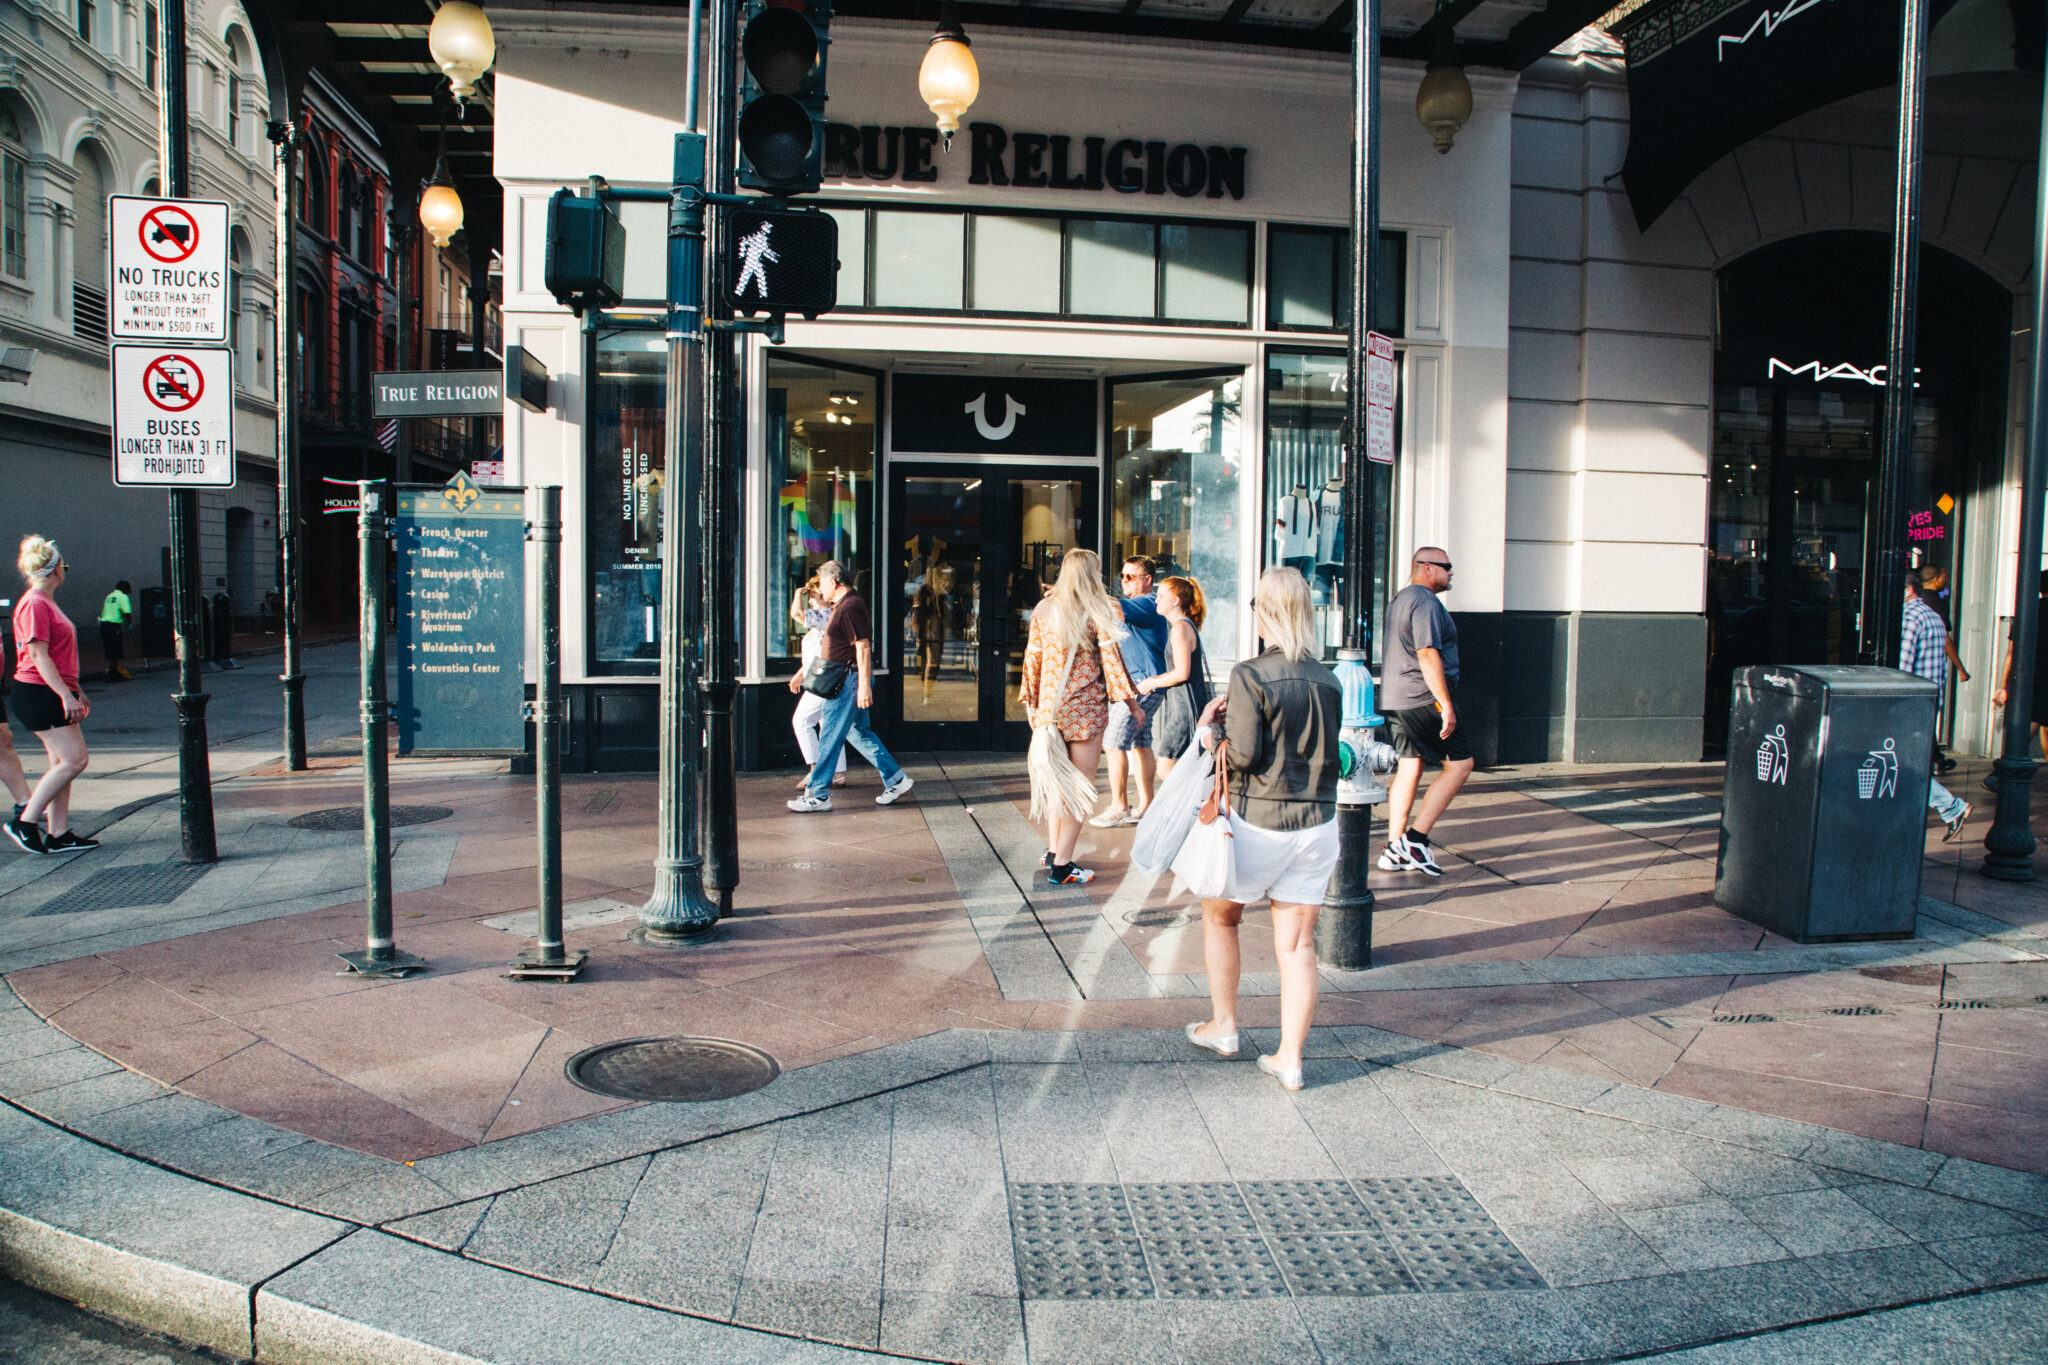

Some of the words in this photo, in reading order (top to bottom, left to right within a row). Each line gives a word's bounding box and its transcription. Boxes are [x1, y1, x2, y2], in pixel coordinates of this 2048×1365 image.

[824, 122, 938, 182] RUE
[968, 121, 1248, 200] RELIGION
[119, 266, 143, 285] NO
[152, 268, 220, 288] TRUCKS
[125, 290, 160, 302] LONGER
[165, 292, 187, 304] THAN
[132, 305, 171, 317] WITHOUT
[175, 307, 206, 318] PERMIT
[123, 319, 164, 331] MINIMUM
[168, 321, 191, 332] $500
[195, 322, 215, 333] FINE
[379, 385, 418, 402] TRUE
[426, 384, 499, 401] RELIGION
[147, 419, 201, 436] BUSES
[121, 438, 162, 454] LONGER
[168, 439, 194, 455] THAN
[200, 440, 210, 455] 31
[216, 440, 227, 455] FT
[144, 458, 205, 474] PROHIBITED
[623, 447, 632, 476] GOES
[623, 478, 632, 501] LINE
[640, 453, 649, 515] UNCROSSED
[324, 499, 360, 508] HOLLYW
[623, 504, 632, 520] NO
[421, 526, 450, 538] French
[454, 527, 488, 538] Quarter
[1907, 525, 1945, 541] PRIDE
[421, 567, 469, 579] Warehouse
[471, 569, 505, 579] District
[421, 589, 449, 599] Casino
[421, 622, 463, 633] Aquarium
[421, 642, 474, 654] Woldenberg
[476, 642, 496, 653] Park
[421, 662, 470, 673] Convention
[472, 662, 500, 673] Center
